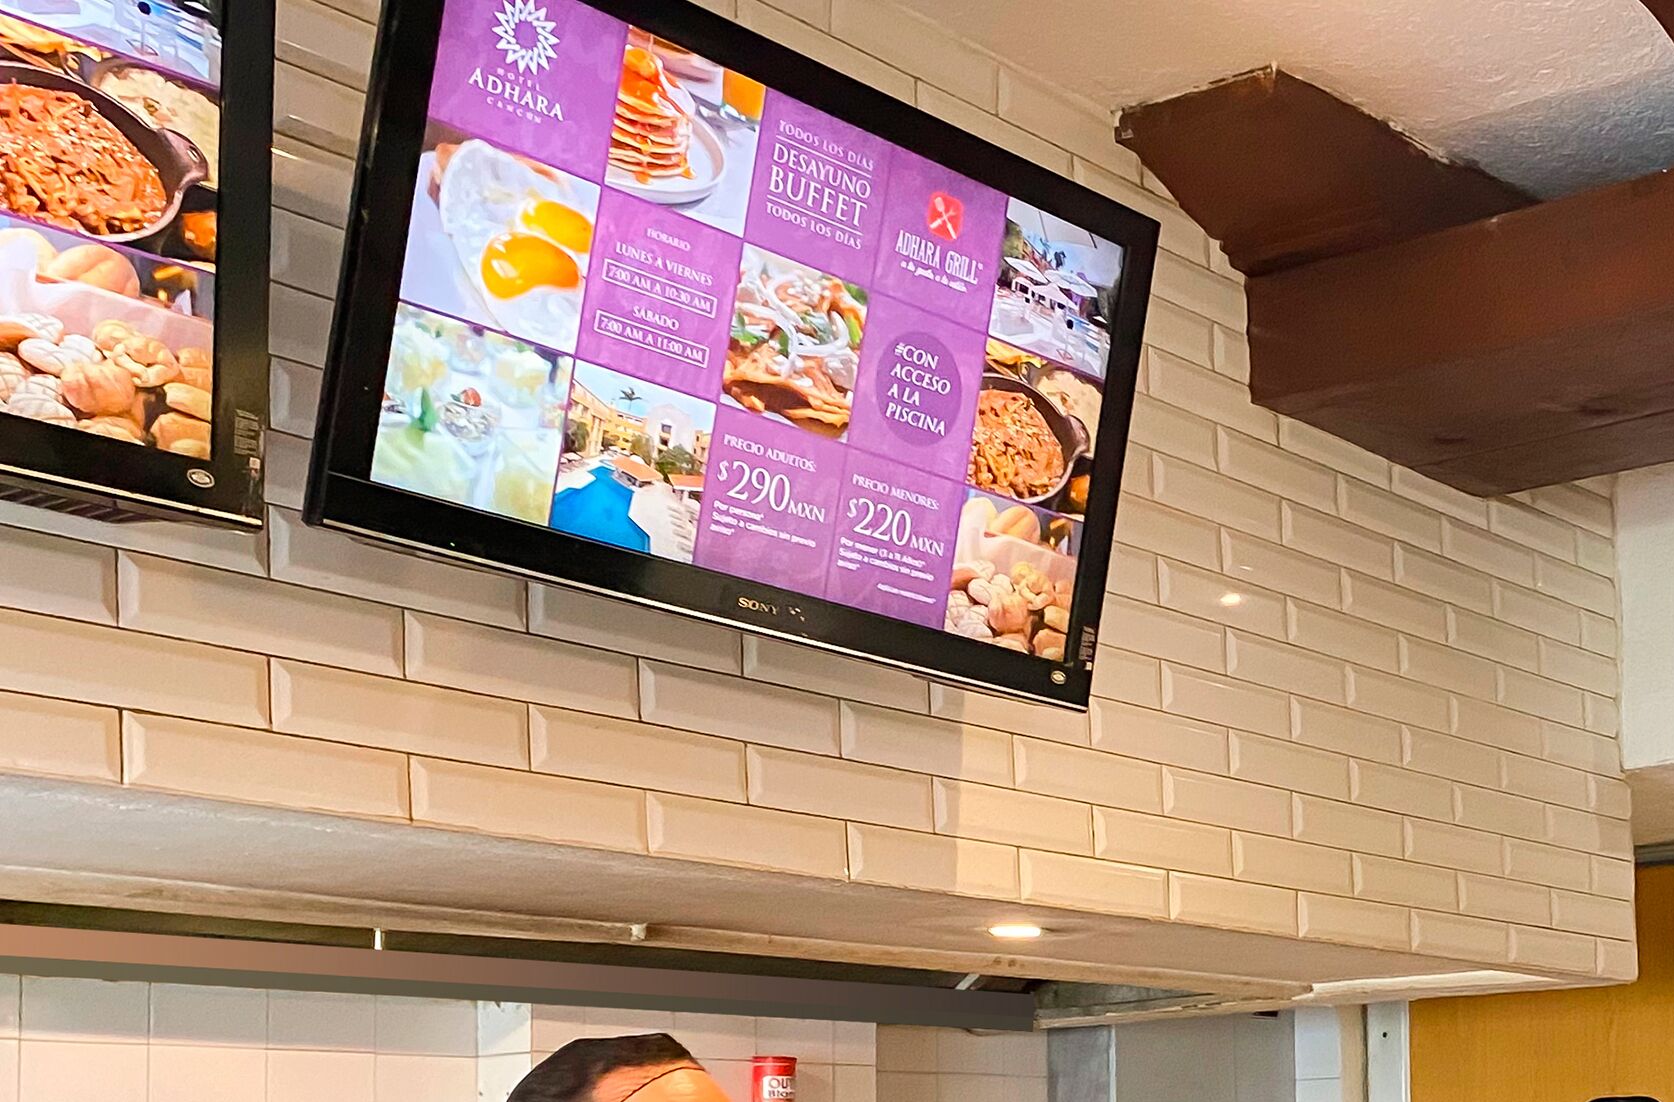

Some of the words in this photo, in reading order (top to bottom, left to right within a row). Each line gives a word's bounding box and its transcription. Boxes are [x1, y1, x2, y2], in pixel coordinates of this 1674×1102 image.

[468, 67, 564, 122] ADHARA
[779, 119, 819, 147] TODOS
[823, 140, 844, 157] LOS
[772, 142, 871, 199] DESAYUNO
[768, 164, 868, 227] BUFFET
[766, 201, 807, 228] TODOS
[810, 220, 832, 238] LOS
[615, 241, 653, 265] LUNES
[655, 257, 664, 270] A
[665, 259, 713, 287] VIERNES
[894, 229, 941, 270] ADHARA
[608, 265, 631, 281] 7:00
[632, 275, 651, 290] AM
[653, 284, 662, 295] A
[692, 296, 711, 312] AM
[600, 316, 623, 334] 7:00
[624, 325, 644, 342] AM
[645, 333, 655, 346] A
[684, 346, 703, 362] AM
[887, 383, 899, 399] A
[902, 386, 920, 406] LA
[890, 362, 951, 395] ACCESO
[885, 401, 946, 436] PISCINA
[723, 433, 765, 456] PRECIO
[852, 473, 889, 495] PRECIO
[738, 597, 777, 616] SONY
